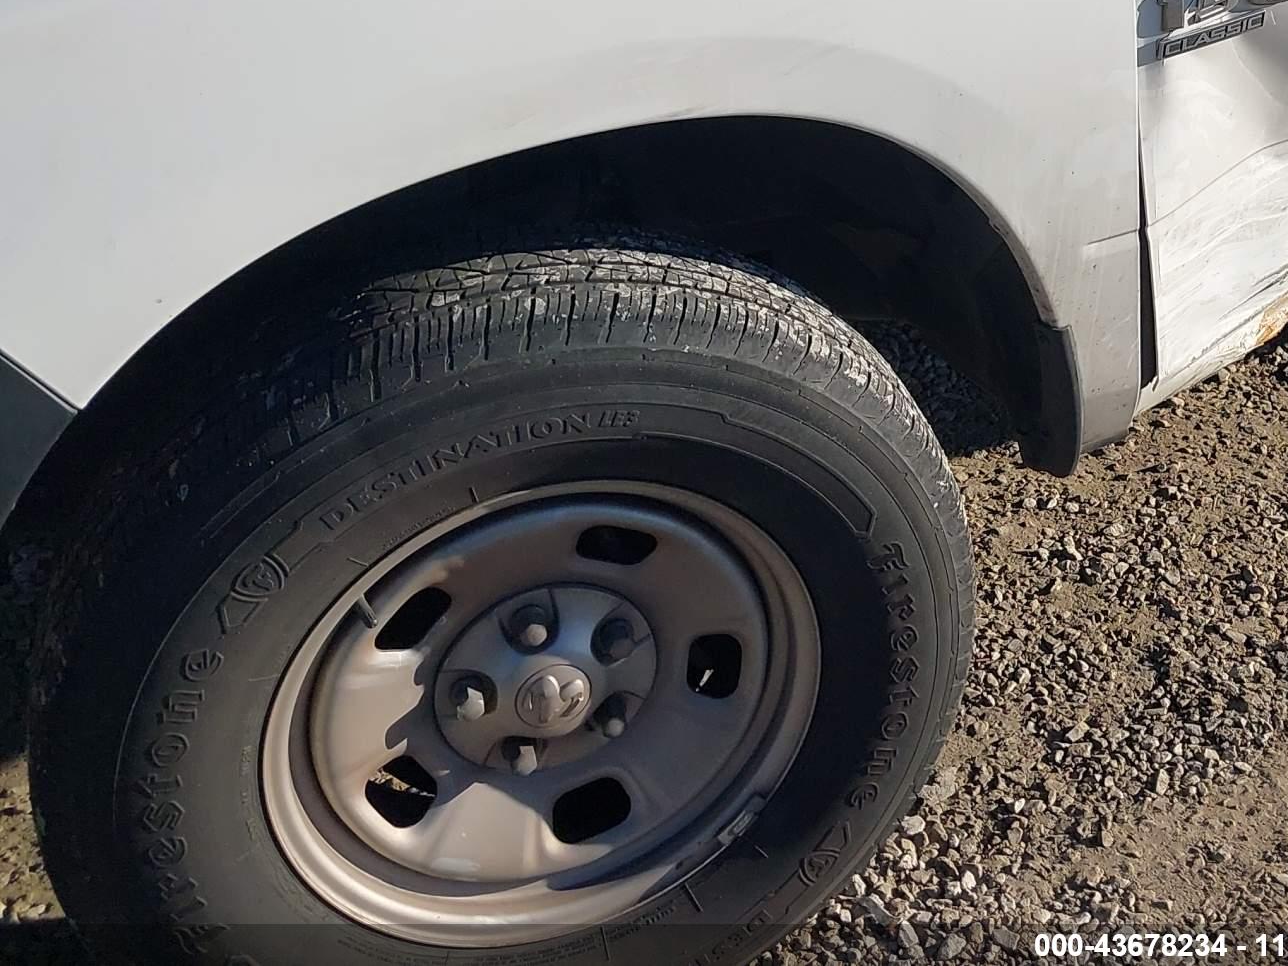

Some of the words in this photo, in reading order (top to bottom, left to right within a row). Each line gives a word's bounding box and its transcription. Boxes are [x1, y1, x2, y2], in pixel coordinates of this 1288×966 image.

[1162, 13, 1266, 58] CLASSIC
[318, 410, 592, 531] DESTINATION
[848, 540, 921, 810] Firestone
